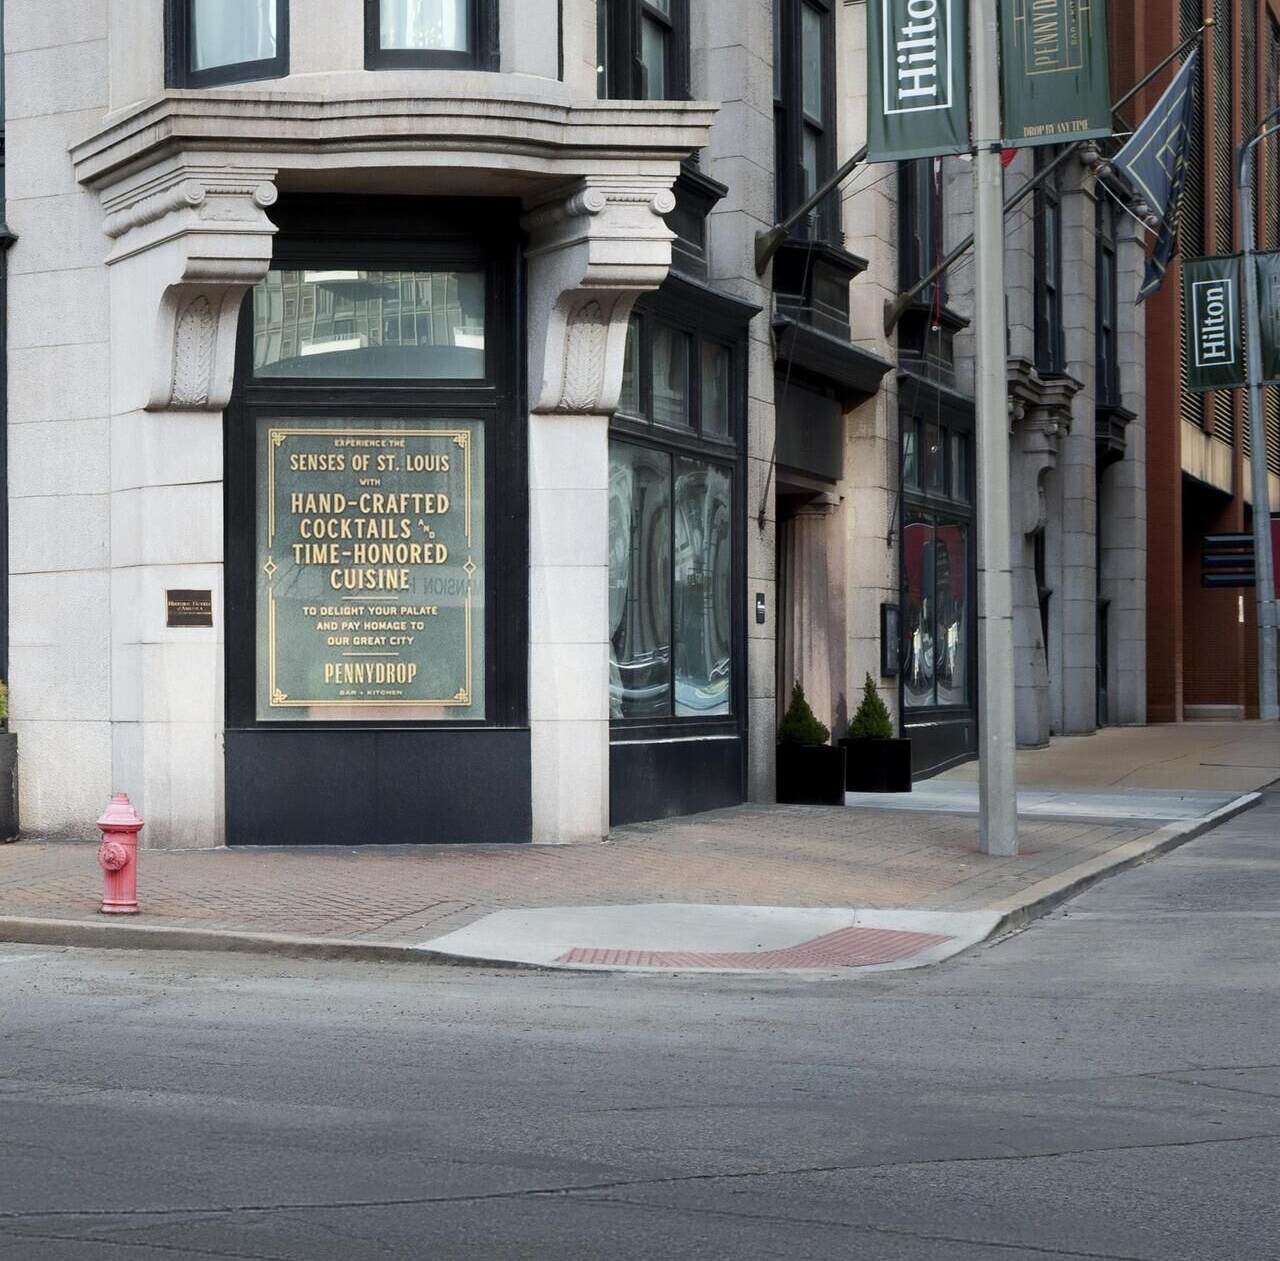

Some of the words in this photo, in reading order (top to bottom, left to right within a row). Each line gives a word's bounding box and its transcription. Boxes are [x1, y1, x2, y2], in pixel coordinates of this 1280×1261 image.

[1024, 125, 1044, 137] DROP
[1202, 286, 1226, 359] Hilton
[334, 439, 386, 447] EXPERIENCE
[389, 439, 406, 447] THE
[290, 454, 345, 471] SENSES
[352, 454, 370, 471] OF
[377, 454, 400, 471] ST.
[406, 454, 449, 471] LOUIS
[359, 478, 381, 487] WITH
[291, 493, 449, 514] HAND-CRAFTED
[300, 519, 411, 539] COCKTAILS
[418, 519, 436, 539] AND
[292, 543, 448, 564] TIME-HONORED
[330, 569, 410, 589] CUISINE
[303, 607, 316, 615] TO
[320, 607, 364, 615] DELIGHT
[368, 606, 397, 615] YOUR
[400, 606, 438, 615] PALATE
[316, 621, 338, 631] AND
[342, 621, 360, 631] PAY
[364, 621, 406, 631] HOMAGE
[410, 621, 424, 631] TO
[328, 637, 350, 645] OUR
[352, 637, 387, 645] GREAT
[390, 637, 414, 645] CITY
[324, 663, 417, 684] PENNYDROP
